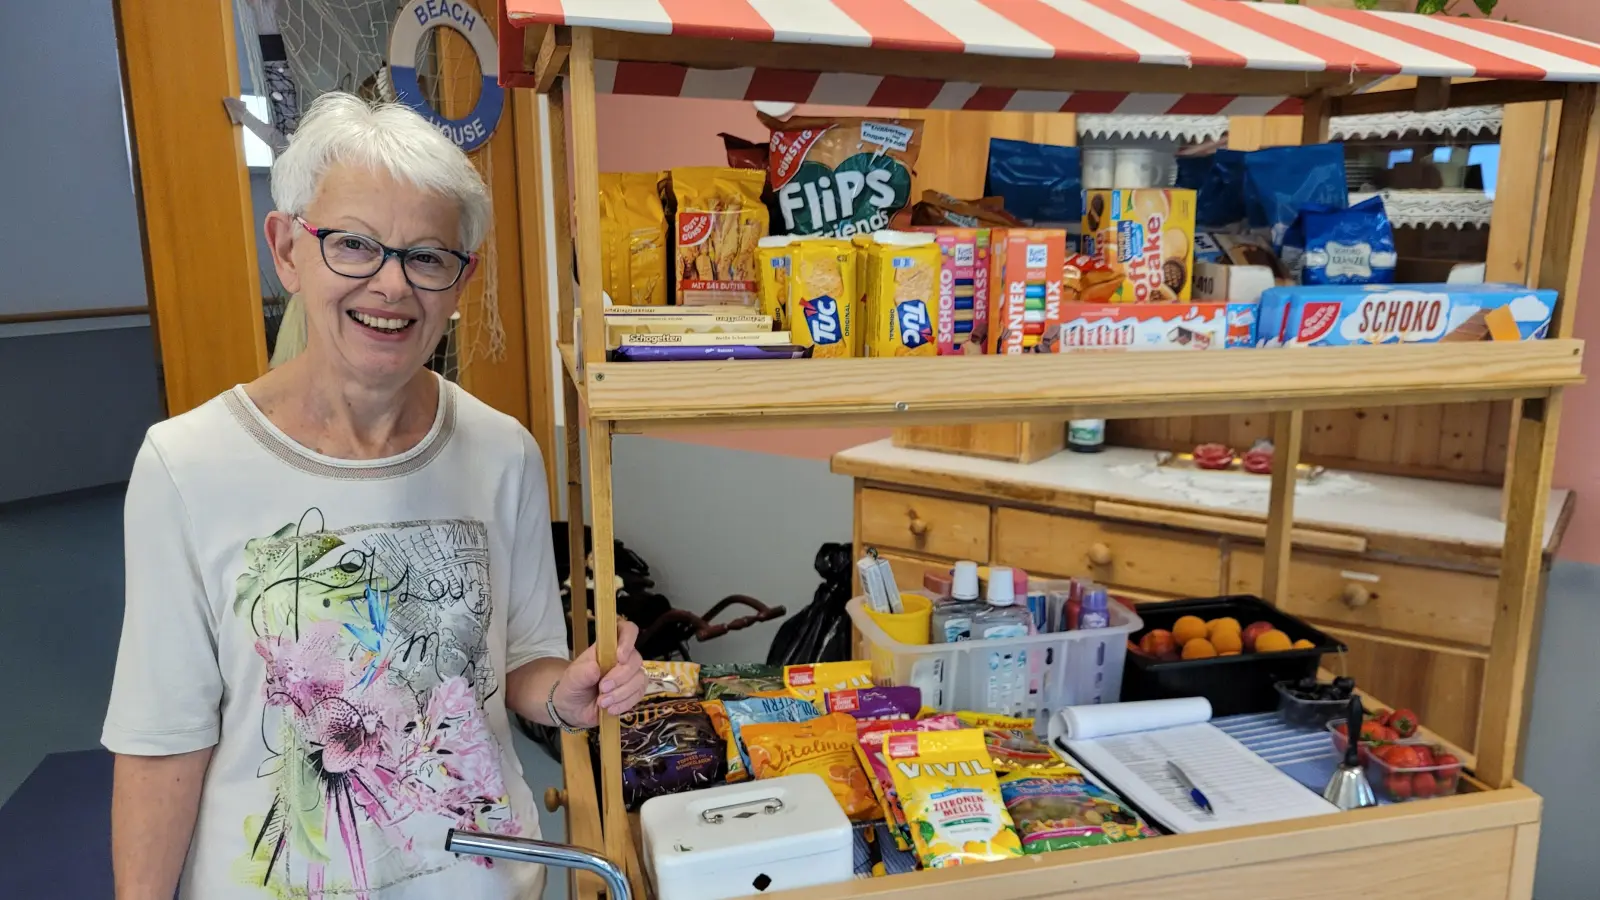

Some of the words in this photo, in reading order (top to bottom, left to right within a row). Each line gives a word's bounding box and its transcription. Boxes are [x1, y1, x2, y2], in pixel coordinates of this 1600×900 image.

[414, 0, 476, 31] BEACH
[769, 130, 785, 152] GUT
[778, 143, 788, 154] &
[1143, 216, 1161, 288] cake
[975, 267, 987, 320] SPASS
[1046, 280, 1061, 320] MIX
[1129, 258, 1148, 303] oft
[811, 300, 837, 343] TUC
[902, 301, 926, 345] TUC
[938, 268, 953, 343] SCHOKO
[1008, 280, 1025, 353] BUNTER
[1358, 299, 1442, 335] SCHOKO
[629, 334, 682, 344] Schogetten
[897, 760, 992, 779] VIVIL
[942, 804, 985, 818] MELISSE
